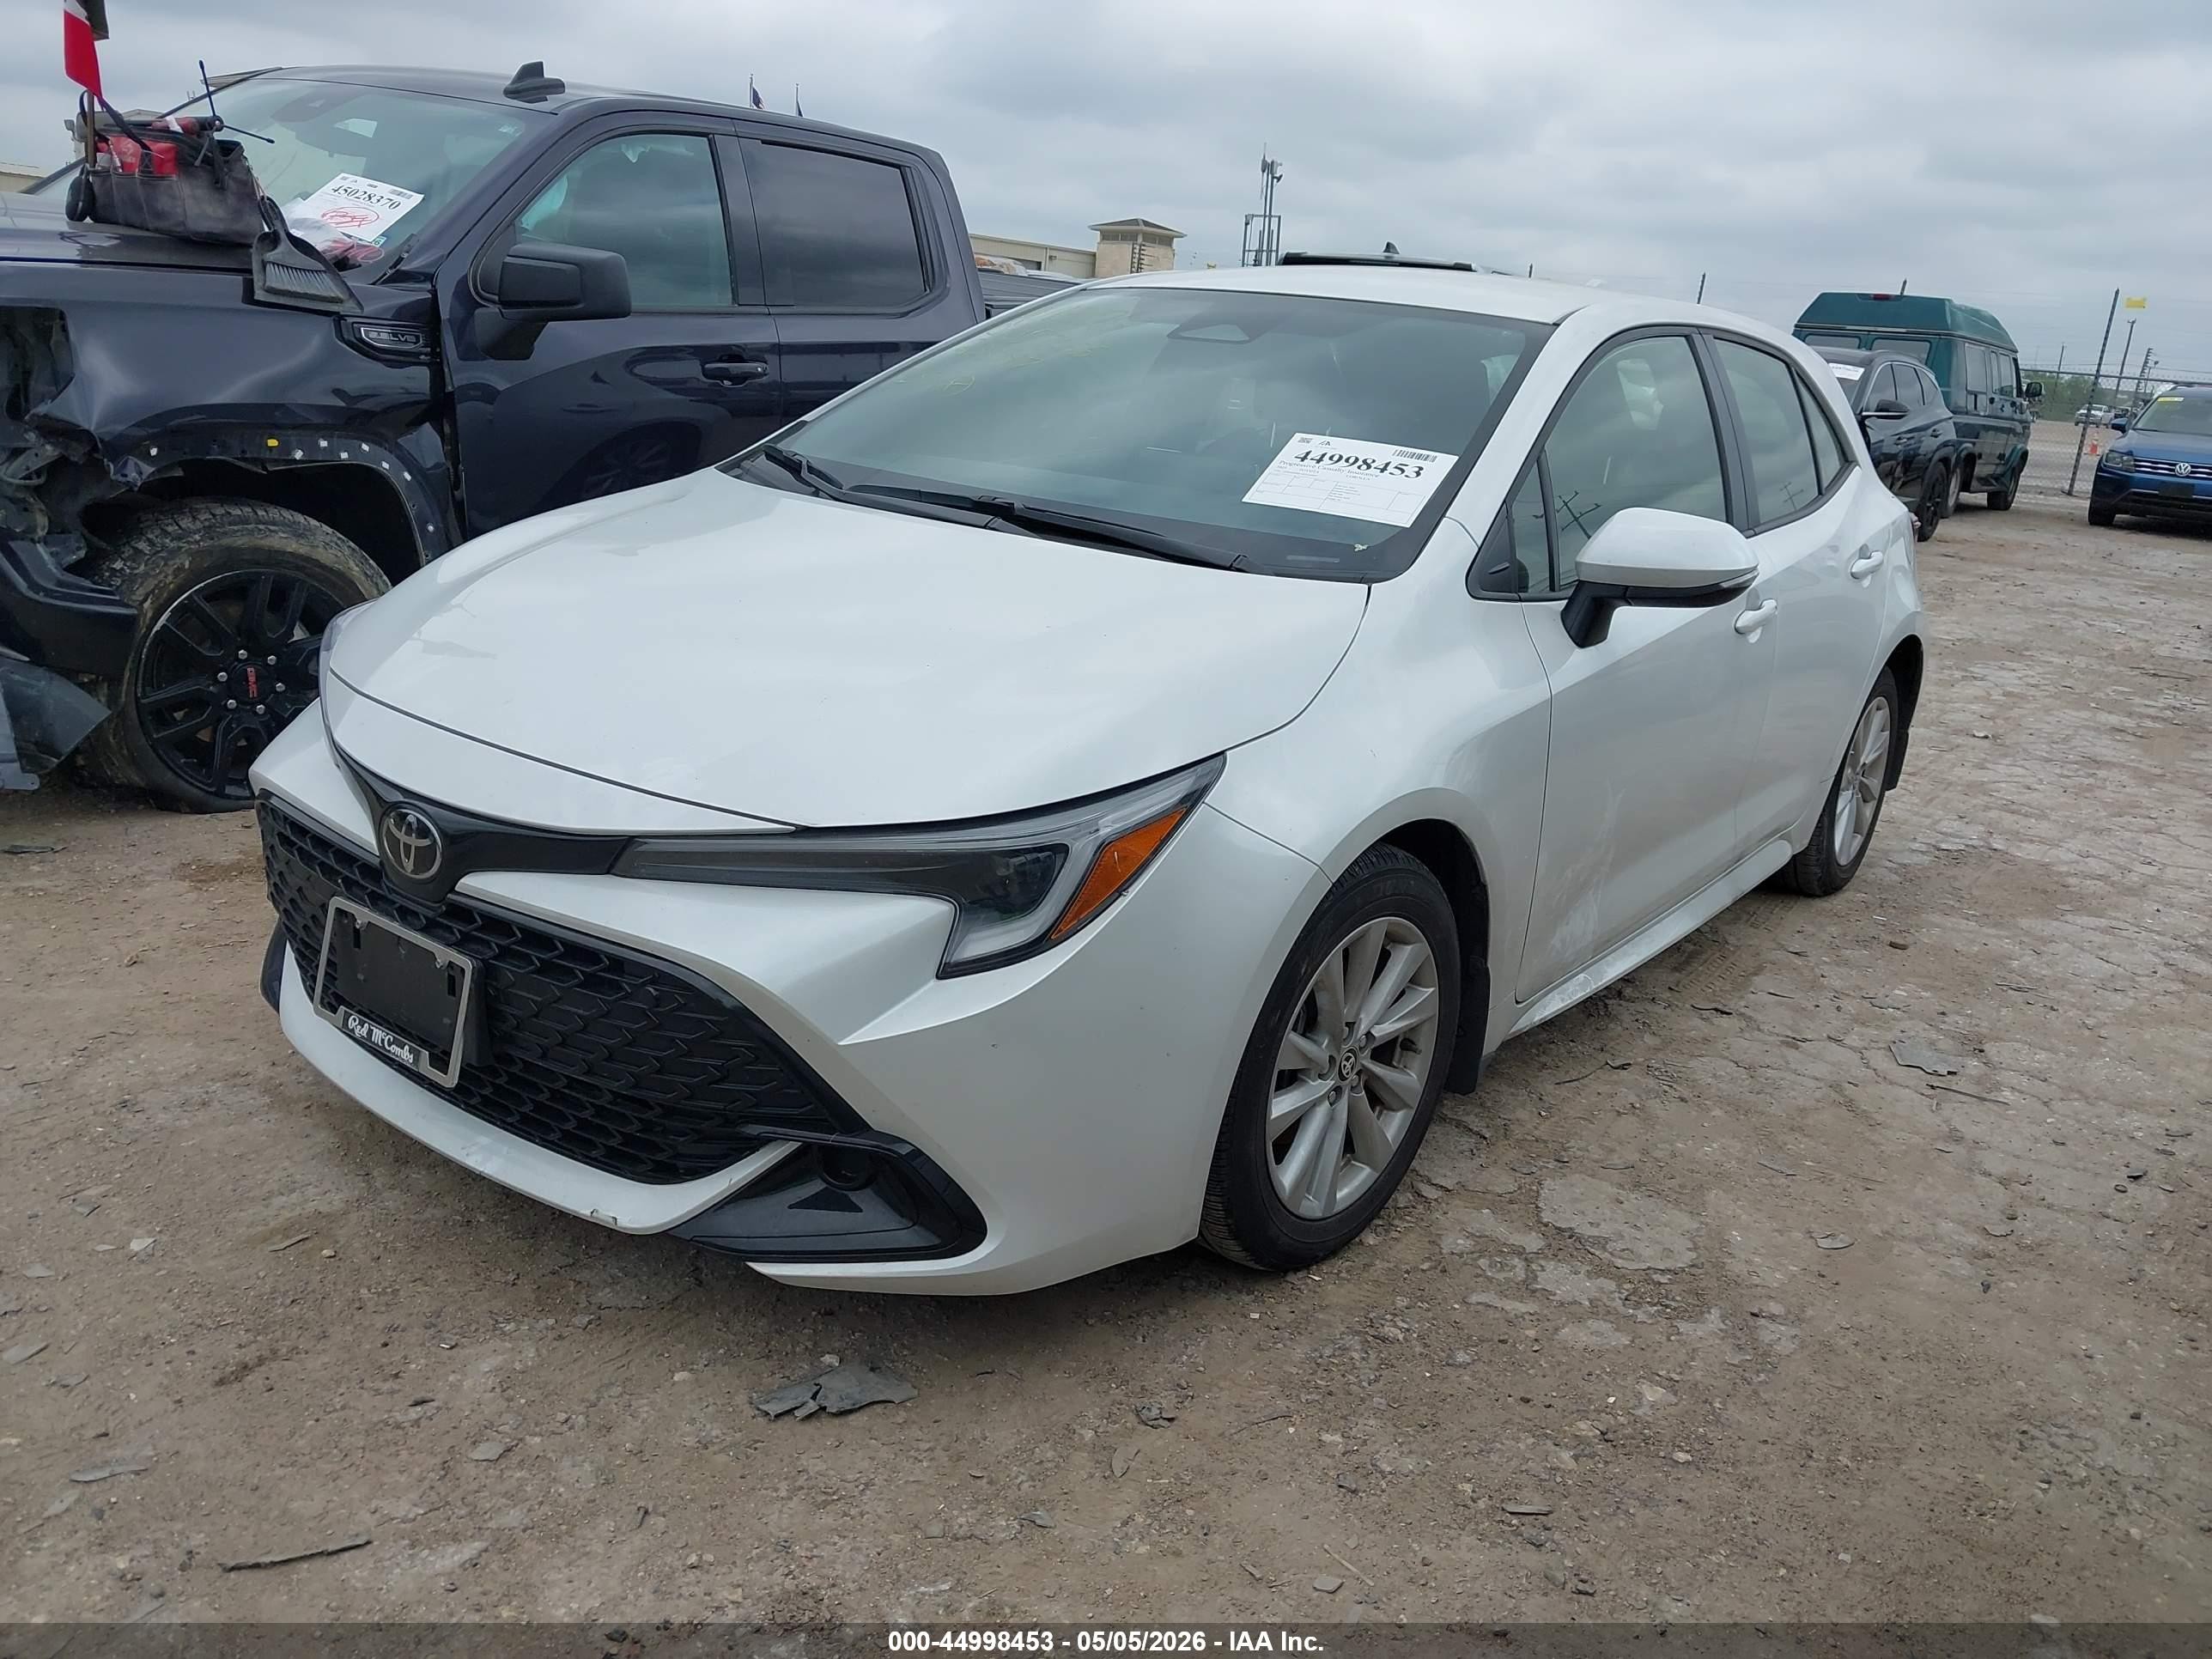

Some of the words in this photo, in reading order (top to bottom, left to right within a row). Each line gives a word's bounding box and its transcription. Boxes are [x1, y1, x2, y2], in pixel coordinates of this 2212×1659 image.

[331, 185, 402, 210] 45028370
[1279, 460, 1316, 469] Progressive
[1347, 470, 1380, 478] Insurance
[1294, 450, 1425, 479] 44998453
[247, 667, 257, 698] GMC
[348, 1015, 369, 1038] Red
[370, 1024, 414, 1064] McCombs
